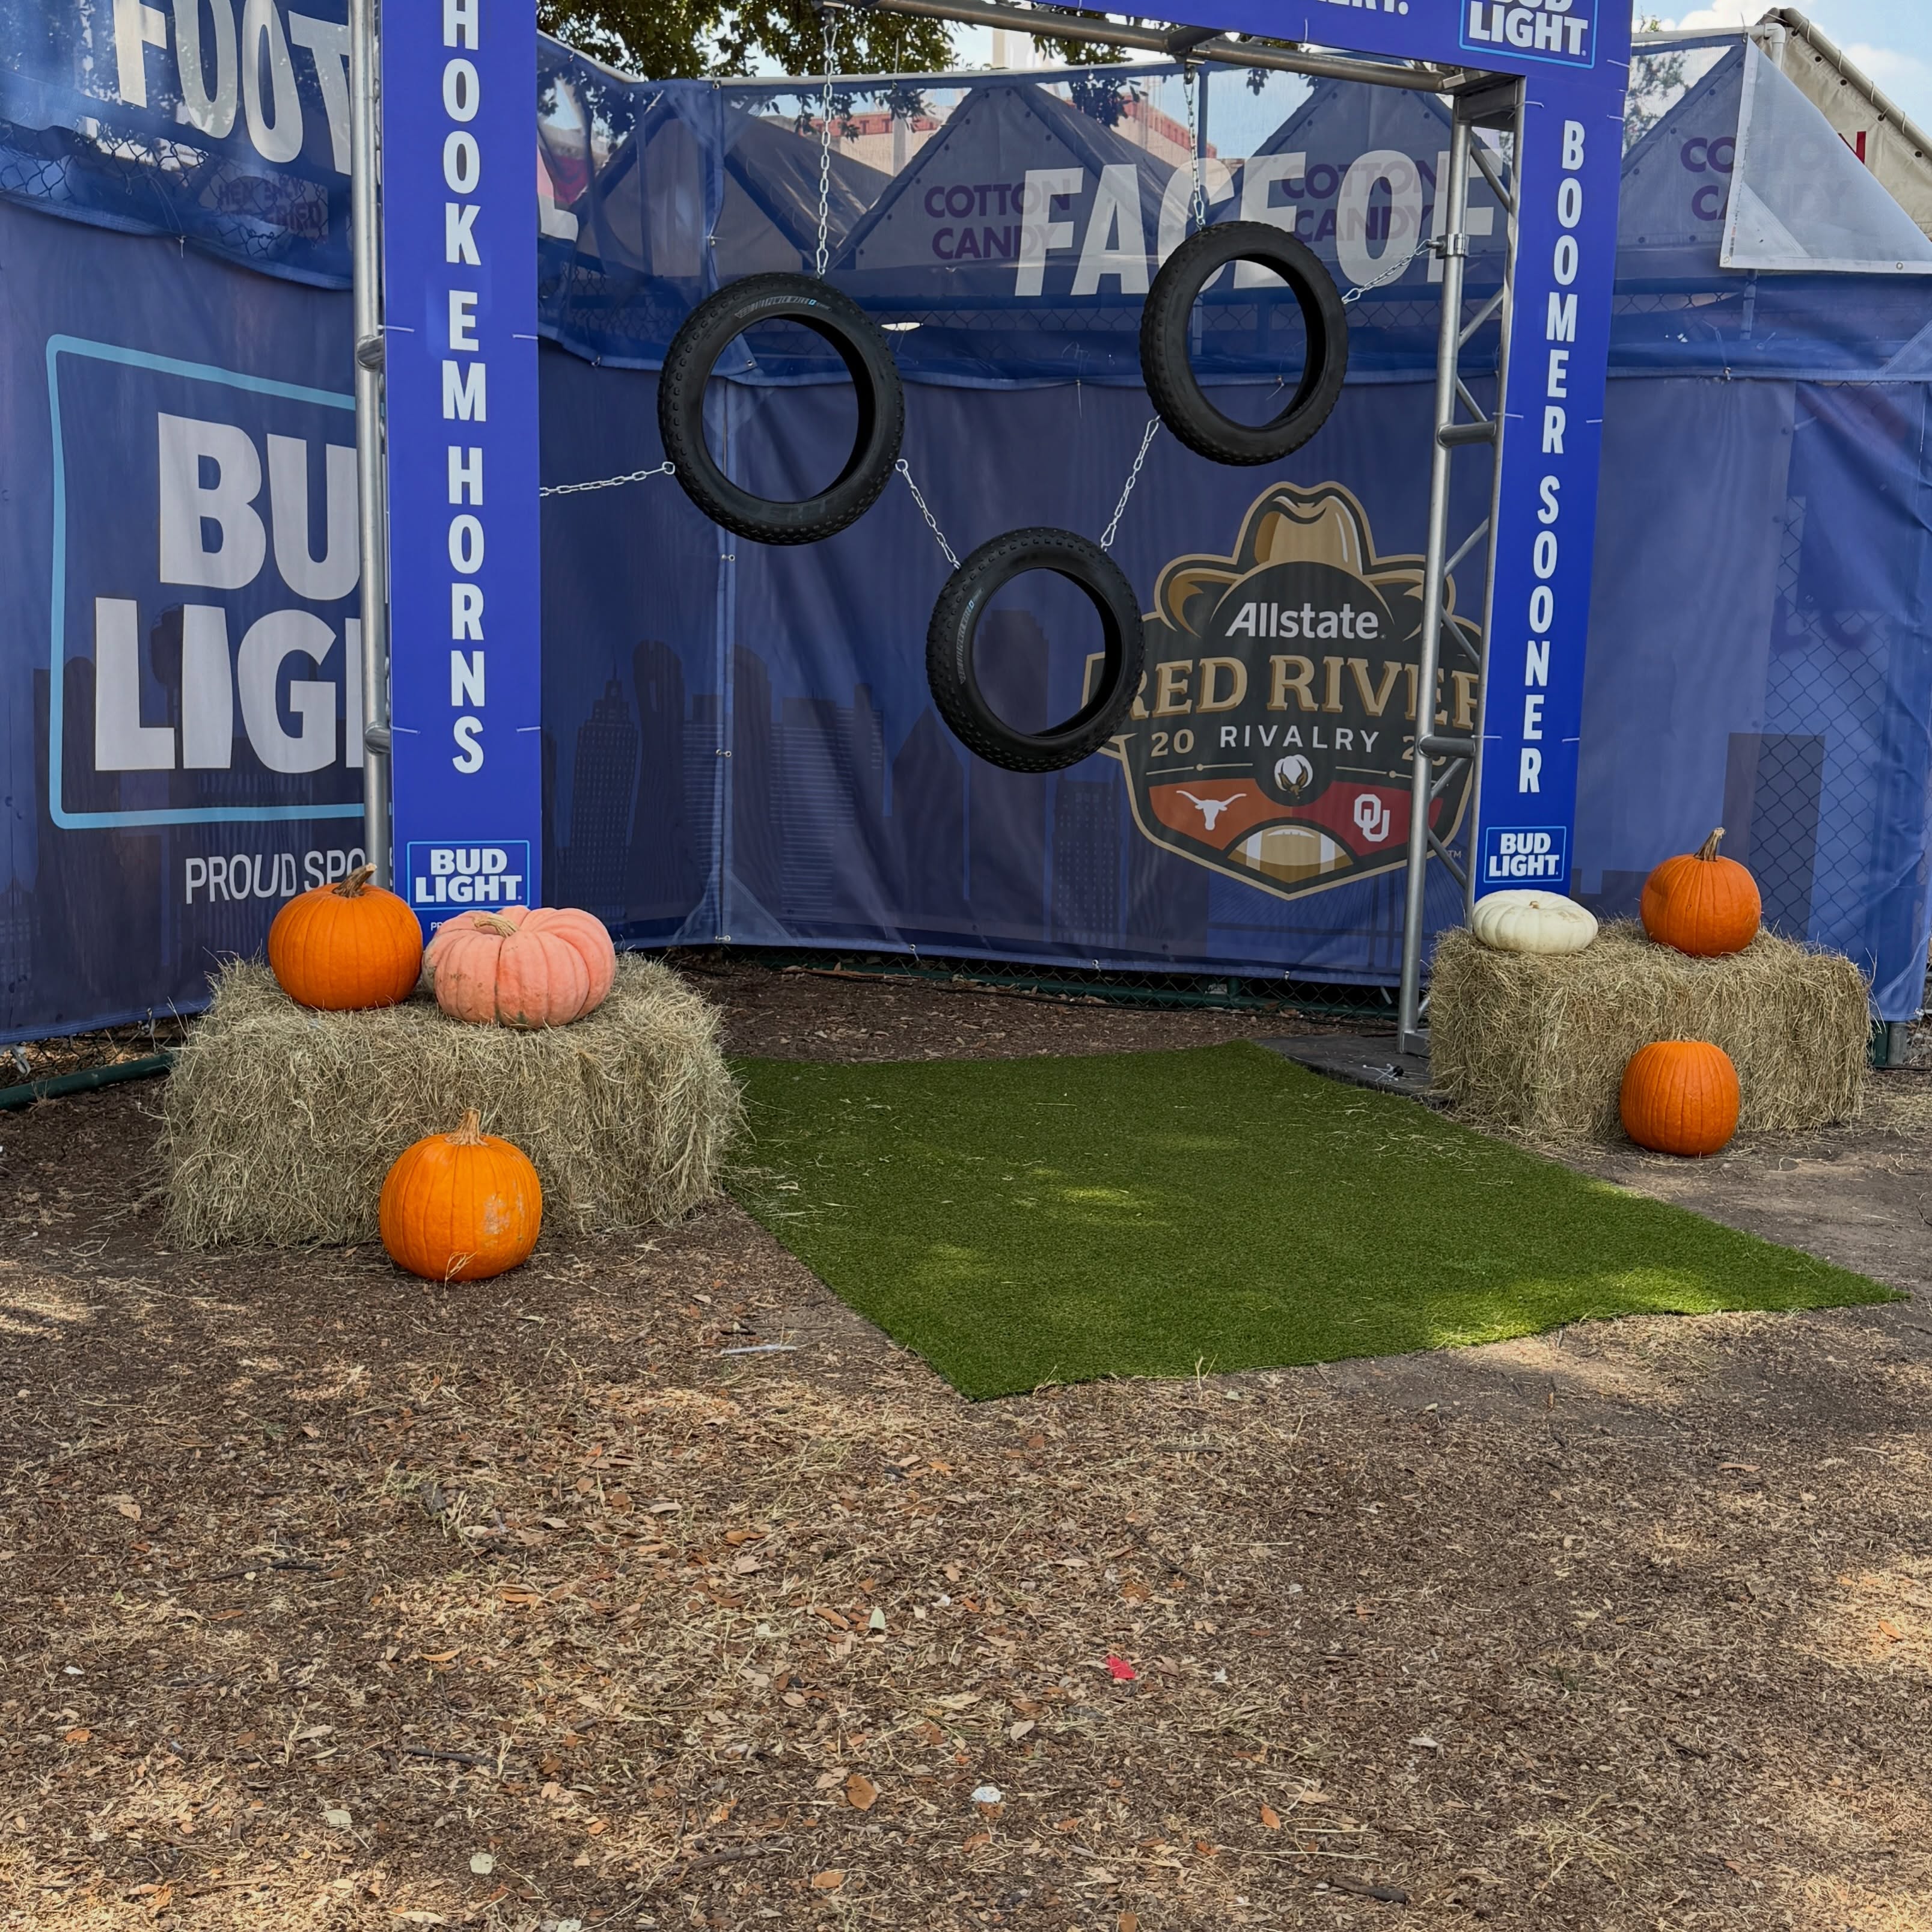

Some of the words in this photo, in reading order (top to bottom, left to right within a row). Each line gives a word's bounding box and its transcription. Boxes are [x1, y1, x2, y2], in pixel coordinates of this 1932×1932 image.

[1469, 1, 1589, 56] LIGHT
[443, 0, 481, 265] HOOK
[924, 179, 1070, 218] COTTON
[1282, 159, 1447, 199] COTTON
[932, 225, 1059, 260] CANDY
[1541, 120, 1585, 454] BOOMER
[442, 290, 486, 421] EM
[158, 412, 361, 600] BU
[447, 446, 485, 774] HORNS
[1224, 602, 1379, 639] Allstate
[1518, 475, 1561, 793] SOONER
[95, 597, 364, 773] LIG
[1150, 729, 1194, 757] 20
[1219, 726, 1379, 753] RIVALRY
[430, 848, 507, 875] BUD
[1489, 854, 1559, 877] LIGHT
[1500, 833, 1551, 855] BUD
[186, 853, 296, 904] PROUD
[415, 875, 522, 903] LIGHT
